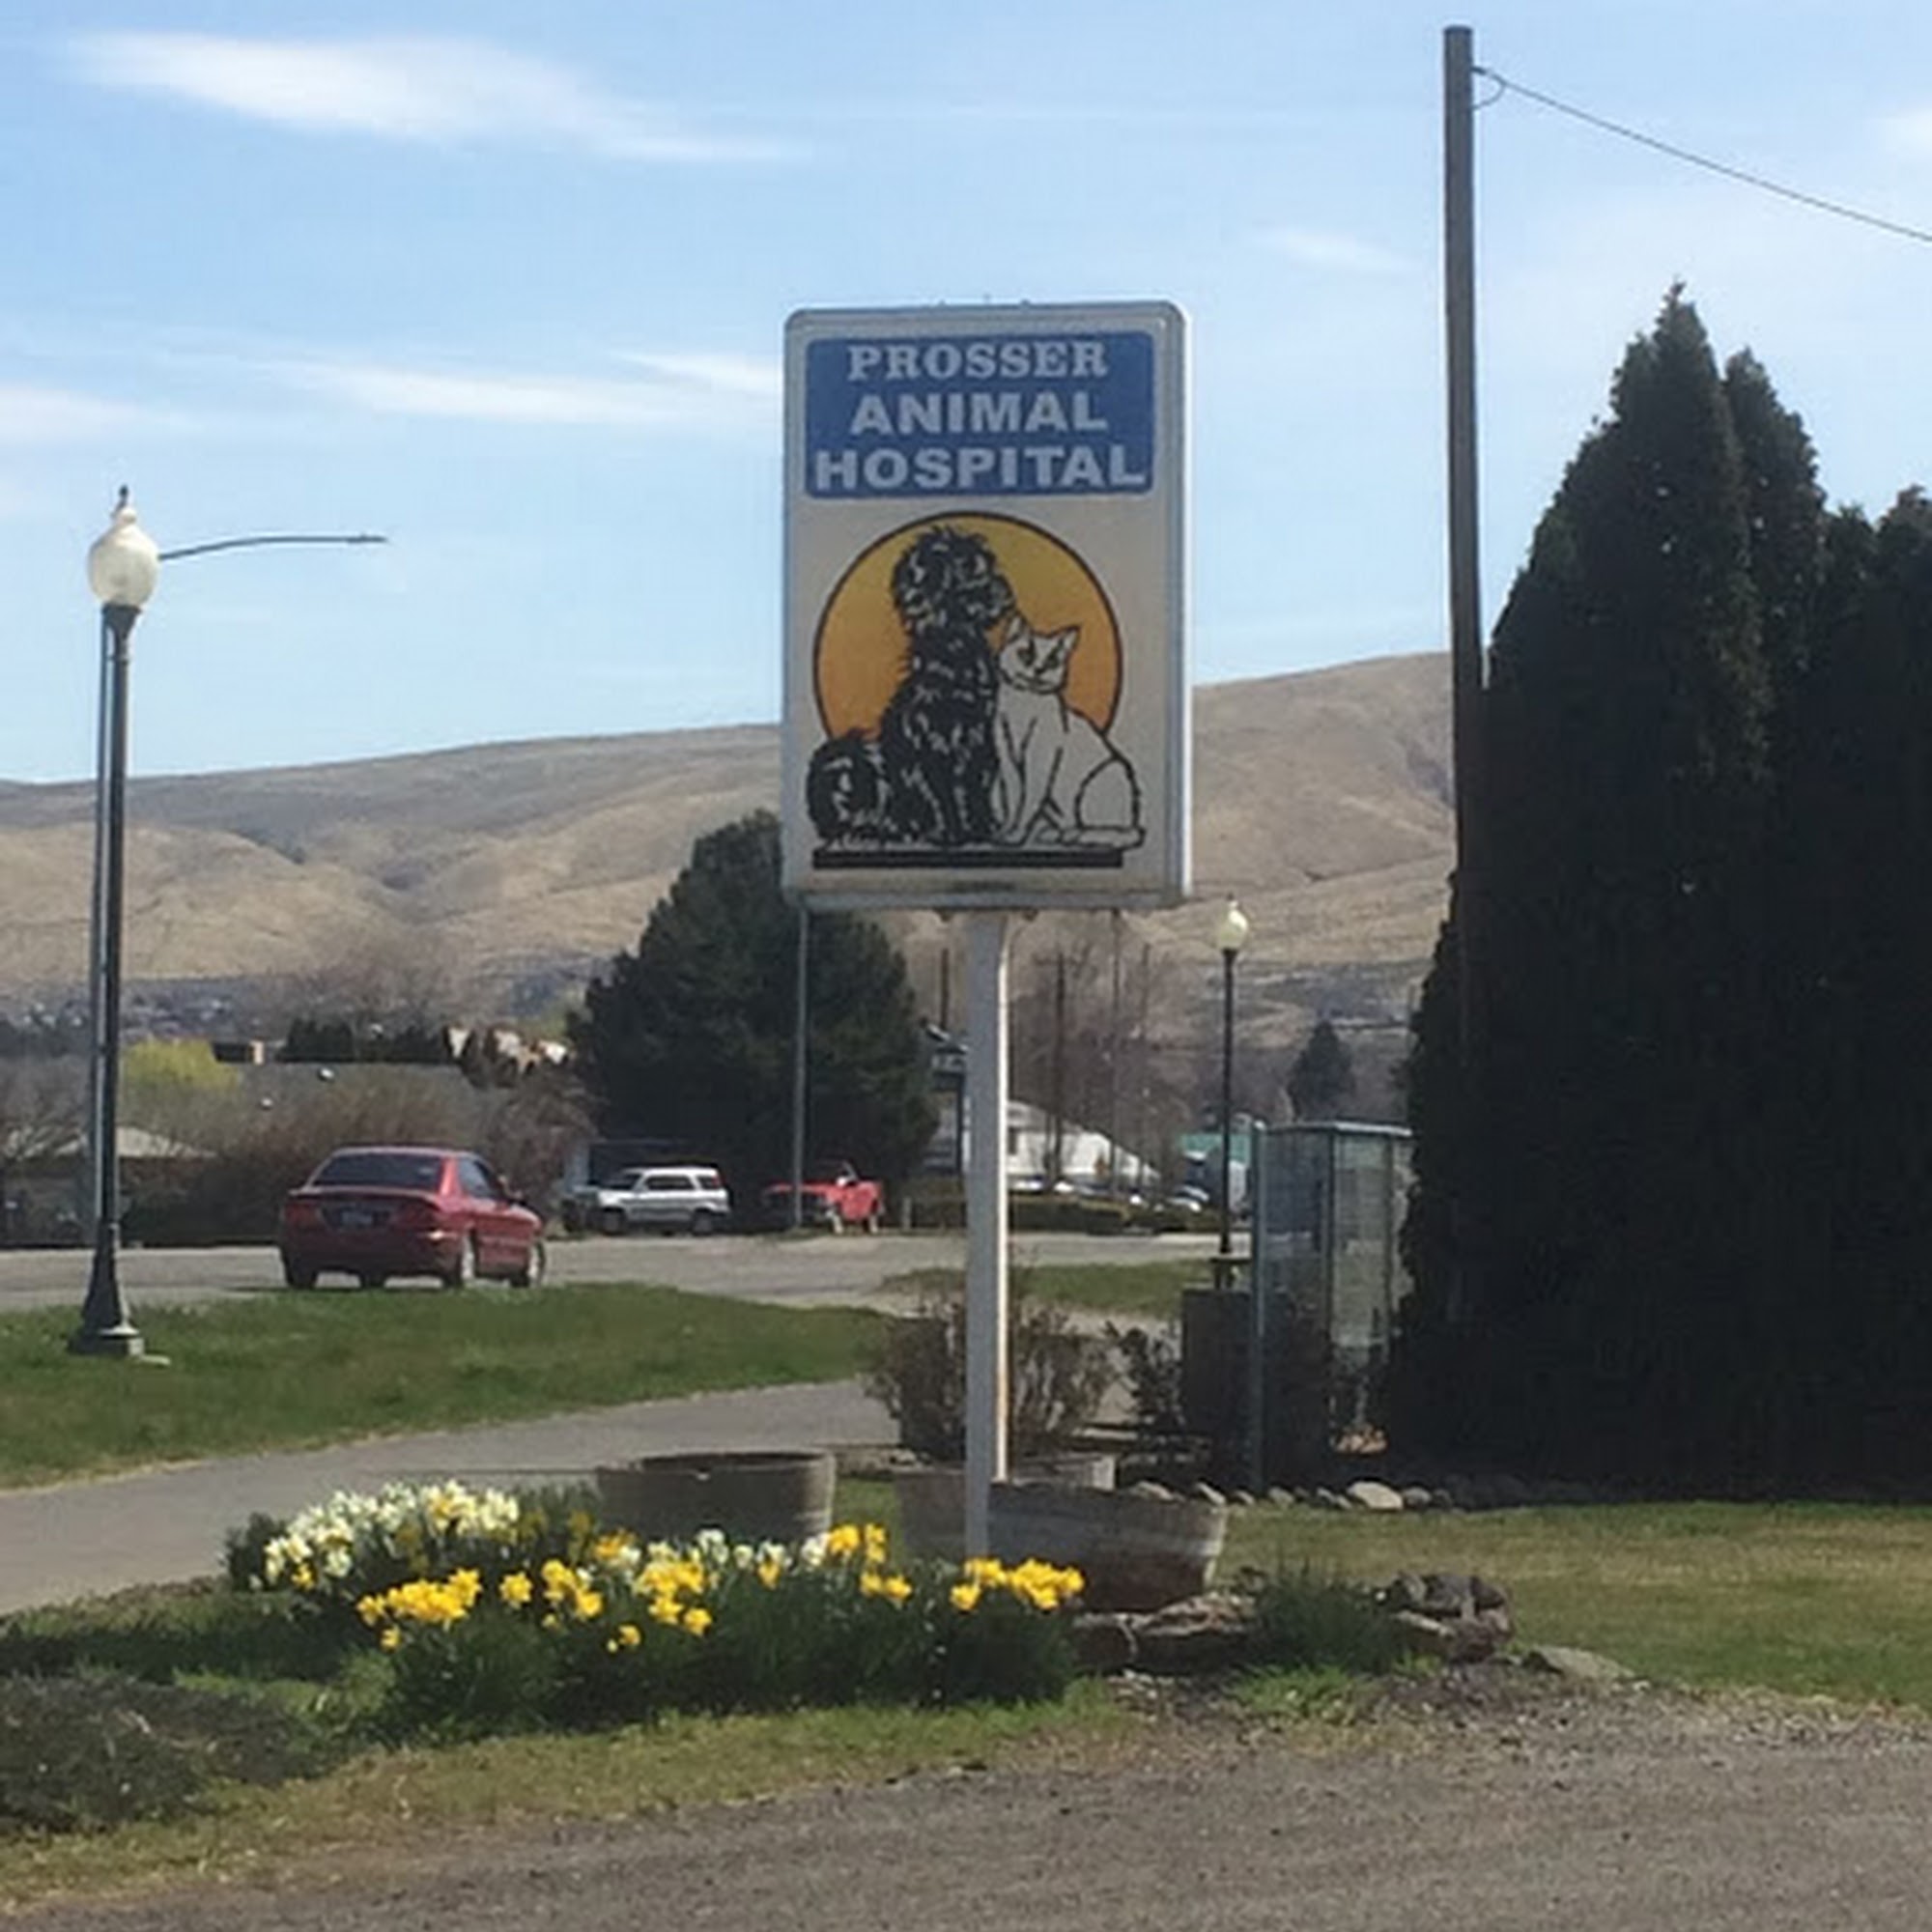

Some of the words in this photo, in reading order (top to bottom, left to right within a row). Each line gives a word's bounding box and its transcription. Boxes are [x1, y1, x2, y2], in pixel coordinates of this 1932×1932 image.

[847, 341, 1108, 381] PROSSER
[850, 391, 1108, 434] ANIMAL
[815, 445, 1145, 490] HOSPITAL
